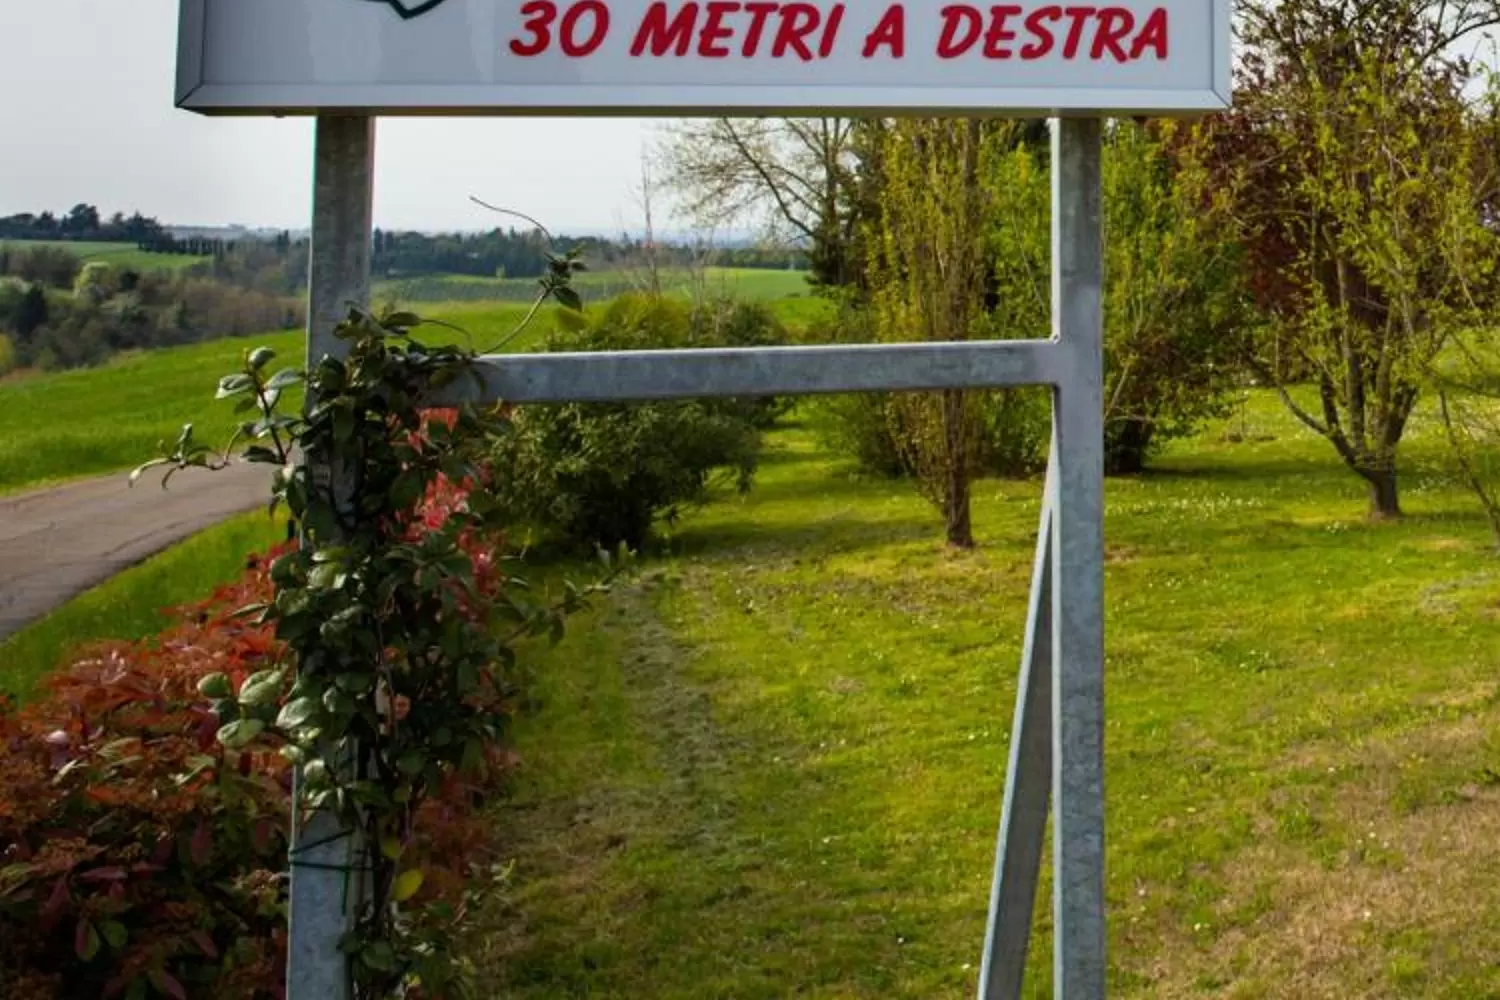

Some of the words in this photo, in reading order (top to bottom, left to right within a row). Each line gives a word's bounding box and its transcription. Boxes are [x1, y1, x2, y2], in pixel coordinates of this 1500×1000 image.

[629, 0, 845, 60] METRI
[862, 3, 906, 59] A
[936, 4, 1170, 62] DESTRA
